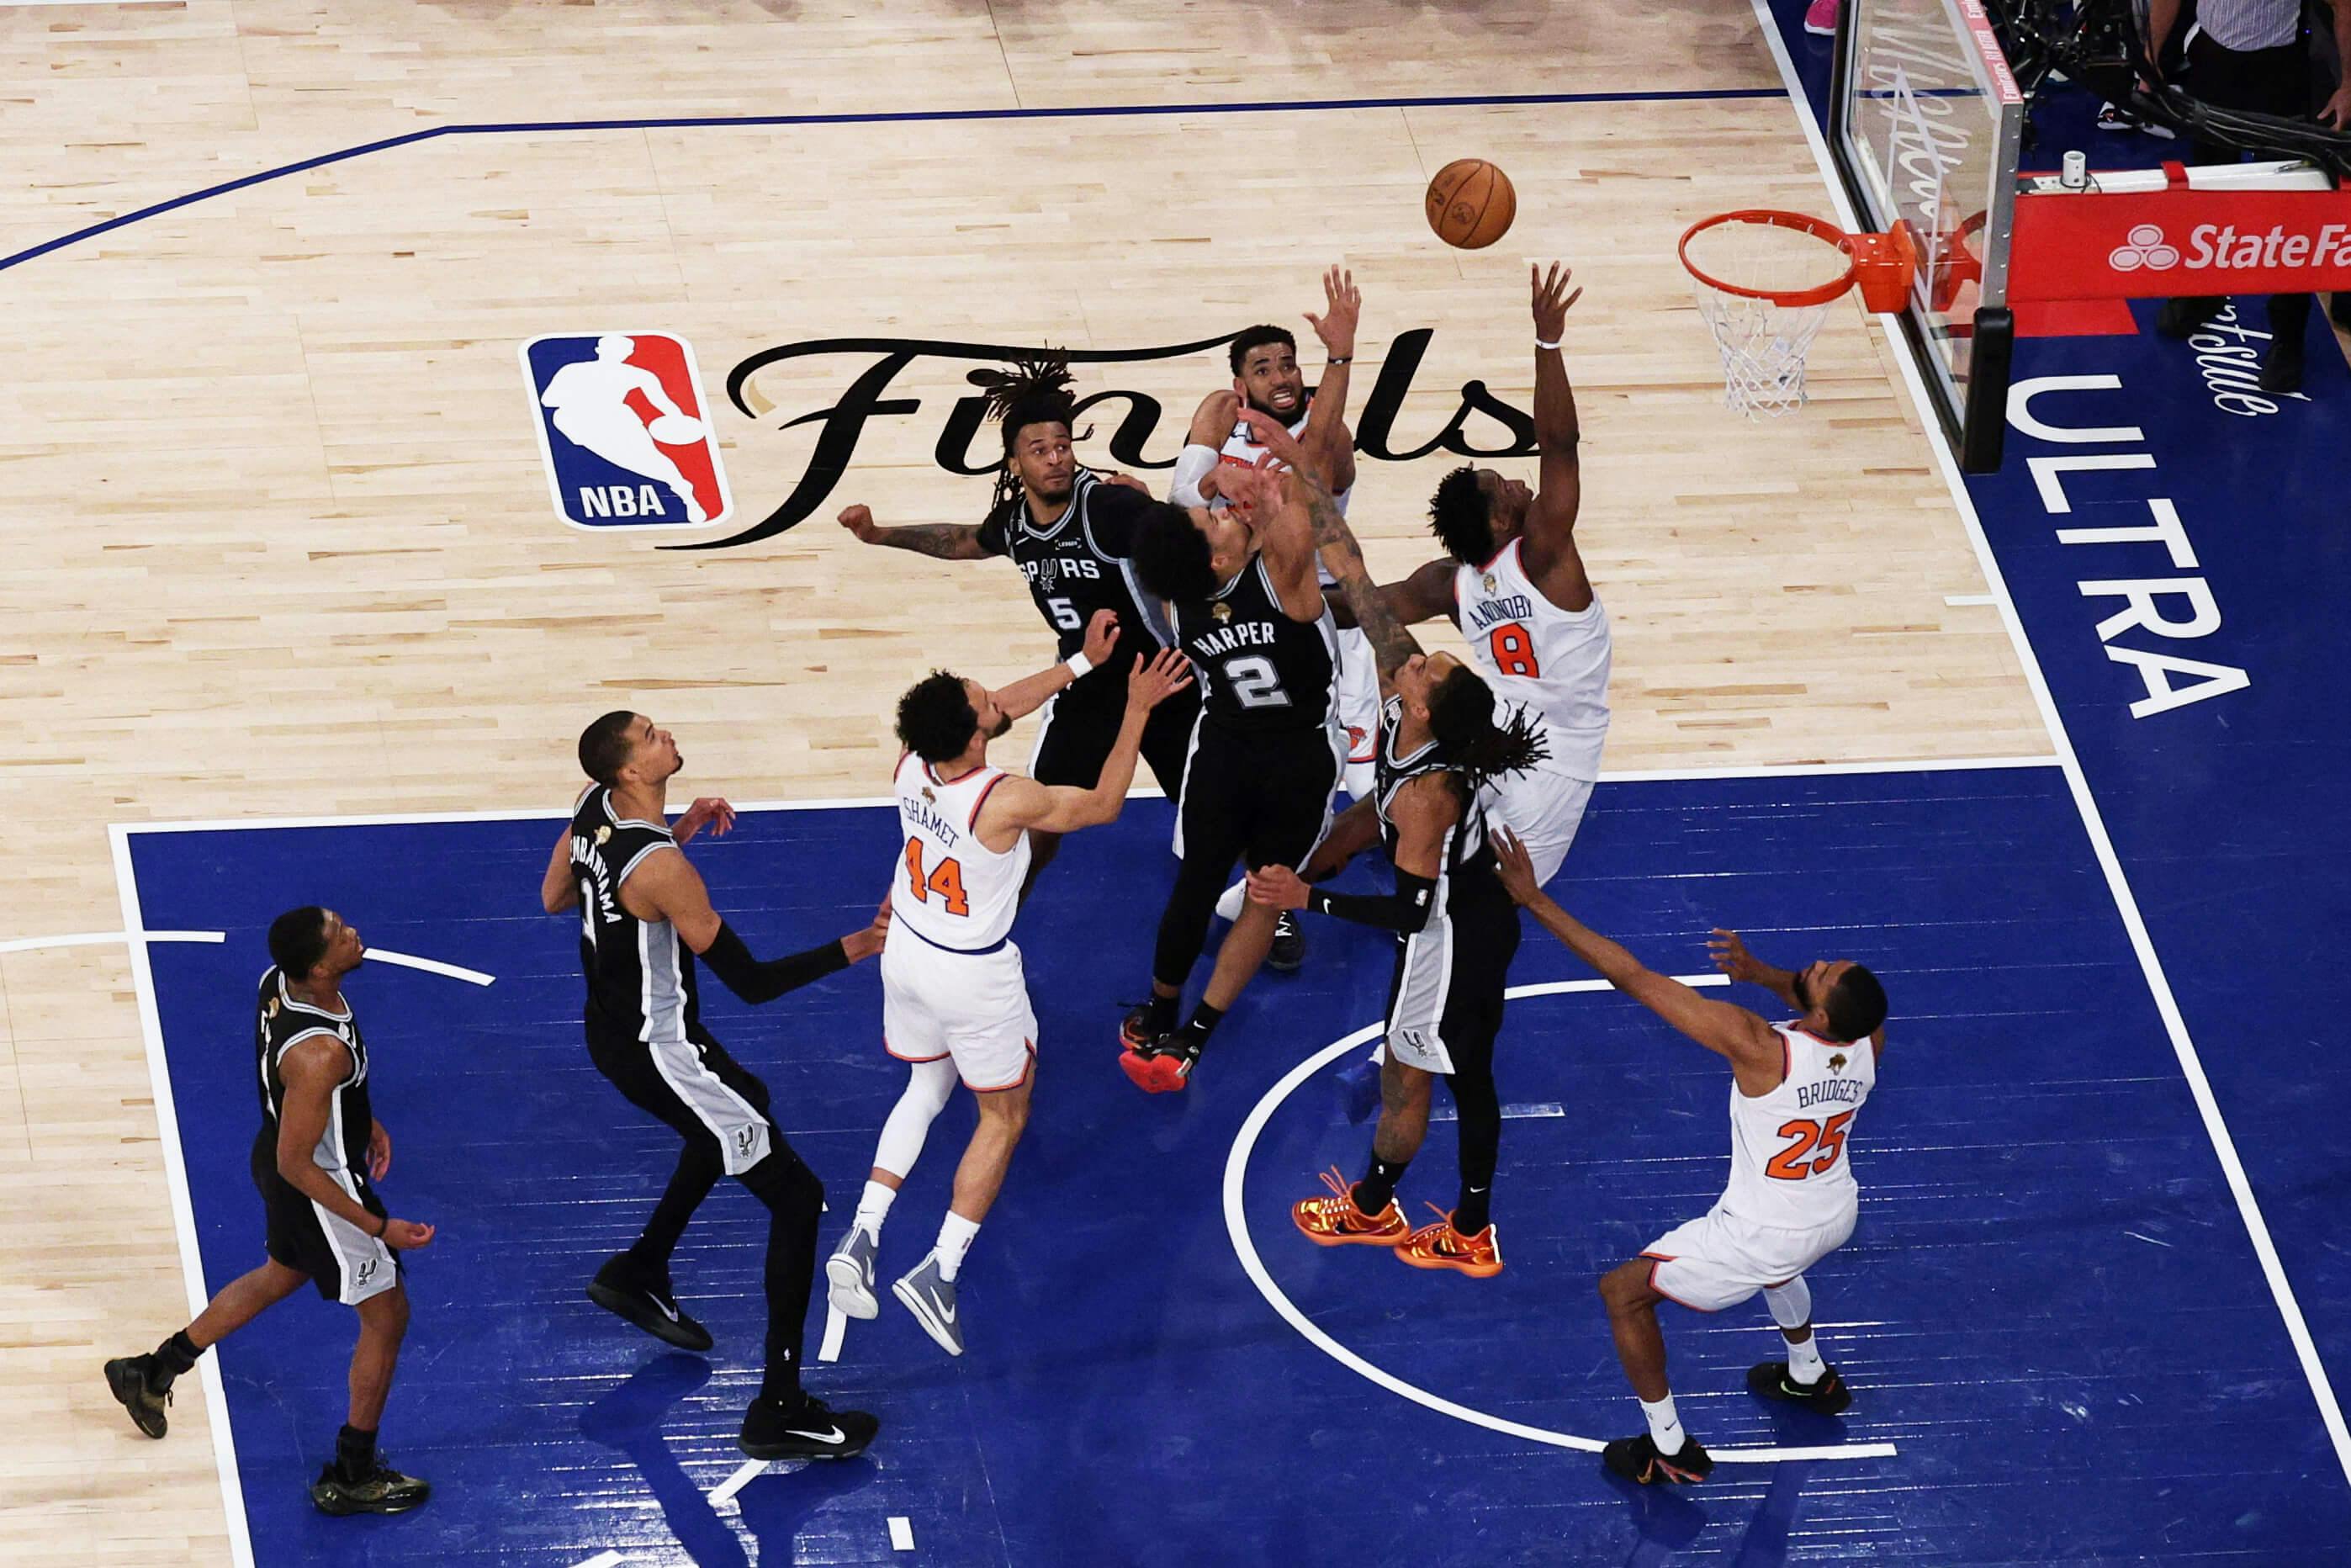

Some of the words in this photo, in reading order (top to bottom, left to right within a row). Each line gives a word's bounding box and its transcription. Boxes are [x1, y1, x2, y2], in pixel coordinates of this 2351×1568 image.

[579, 485, 666, 518] NBA
[2005, 373, 2252, 720] ULTRA
[1046, 597, 1082, 630] 5
[1192, 622, 1276, 657] HARPER
[1489, 621, 1541, 679] 8
[1222, 654, 1294, 710] 2
[903, 796, 960, 849] SHAMET
[905, 834, 970, 918] 44
[1797, 1078, 1864, 1110] BRIDGES
[1764, 1107, 1858, 1181] 25
